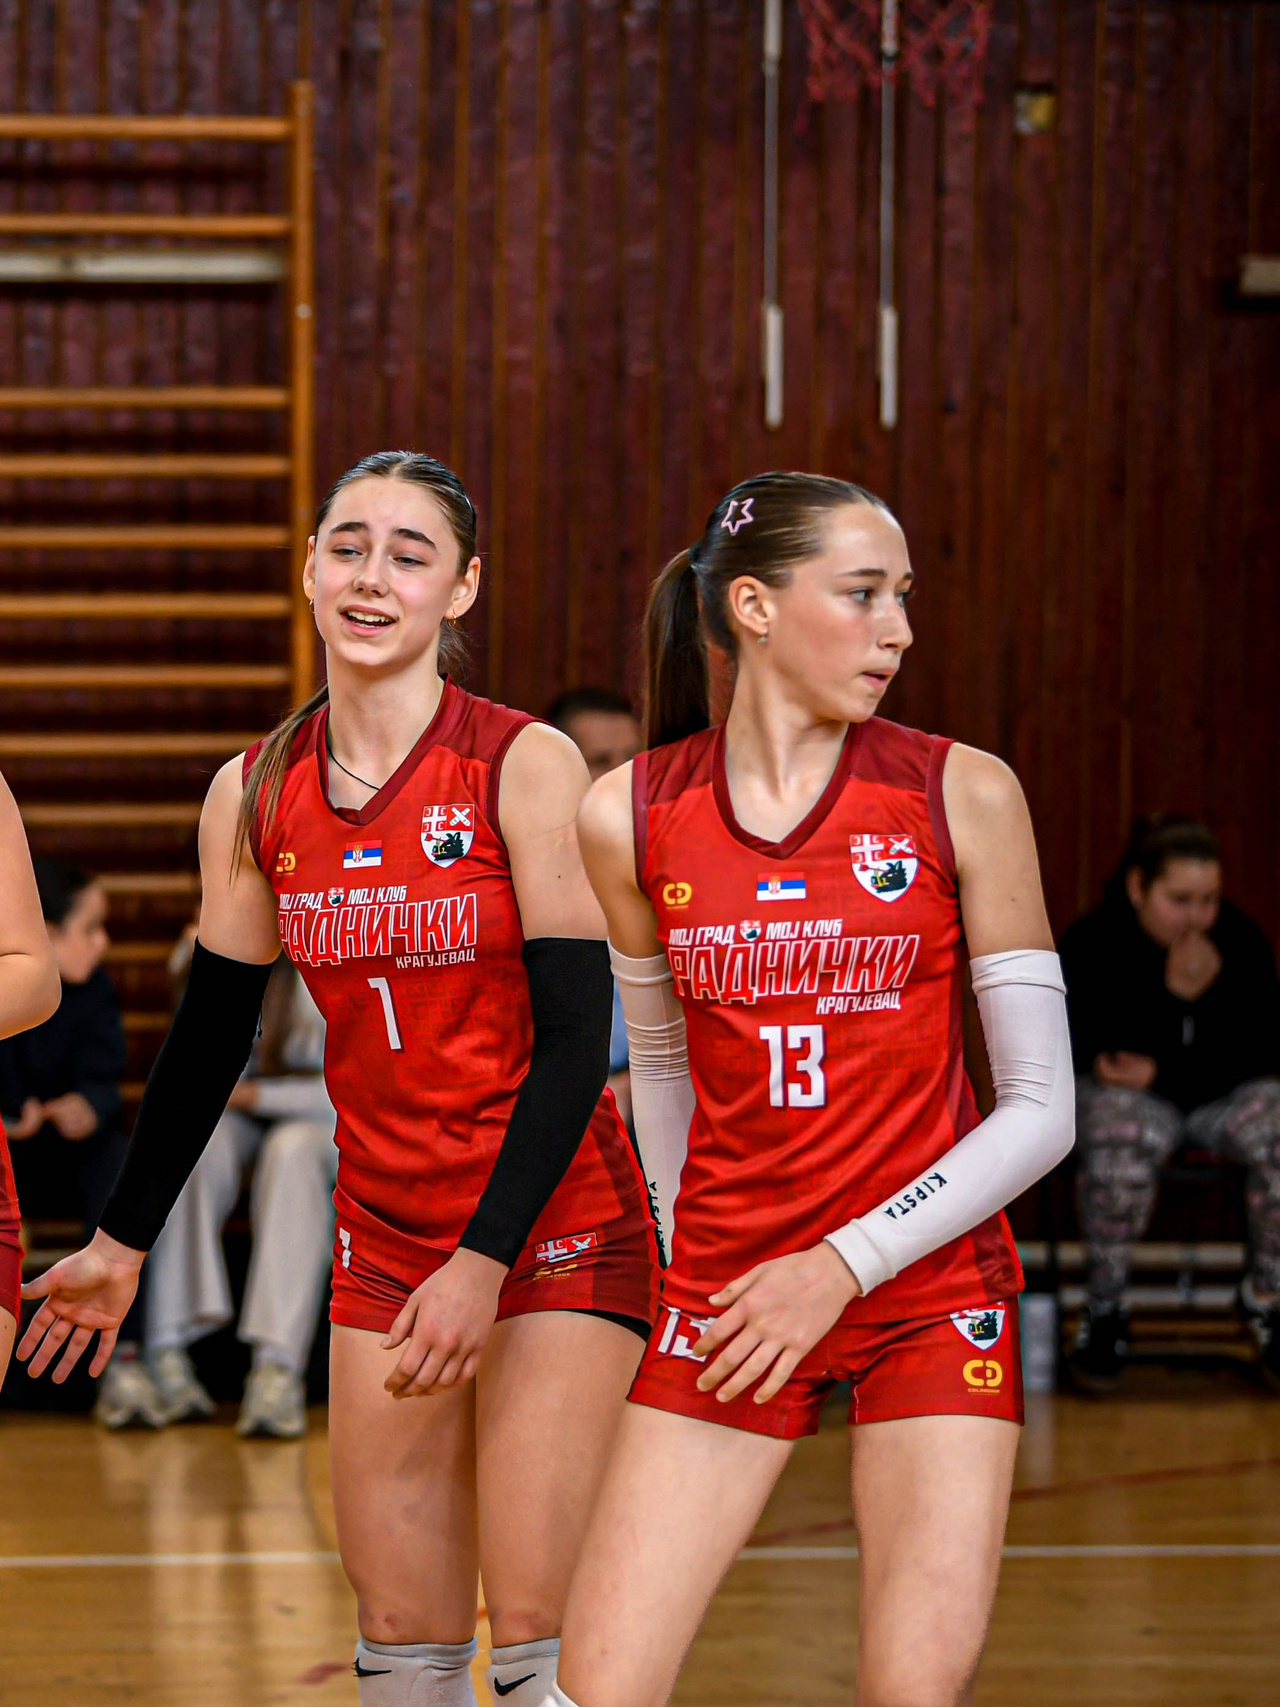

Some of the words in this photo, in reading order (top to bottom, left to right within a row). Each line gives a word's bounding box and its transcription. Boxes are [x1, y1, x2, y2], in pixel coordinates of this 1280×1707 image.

[293, 892, 325, 911] ГРАД
[347, 887, 375, 905] МОЈ
[376, 885, 408, 903] КЛУБ
[669, 928, 694, 947] МОЈ
[694, 924, 736, 947] ГРАД
[765, 920, 801, 941] МОЈ
[802, 918, 843, 939] КЛУБ
[395, 948, 476, 969] КРАГУЈЕВАЦ
[668, 934, 920, 1005] РАДНИЧКИ
[367, 976, 403, 1050] 1
[816, 992, 901, 1015] КРАГУЈЕВАЦ
[759, 1024, 827, 1107] 13
[883, 1172, 948, 1220] KIPSTA
